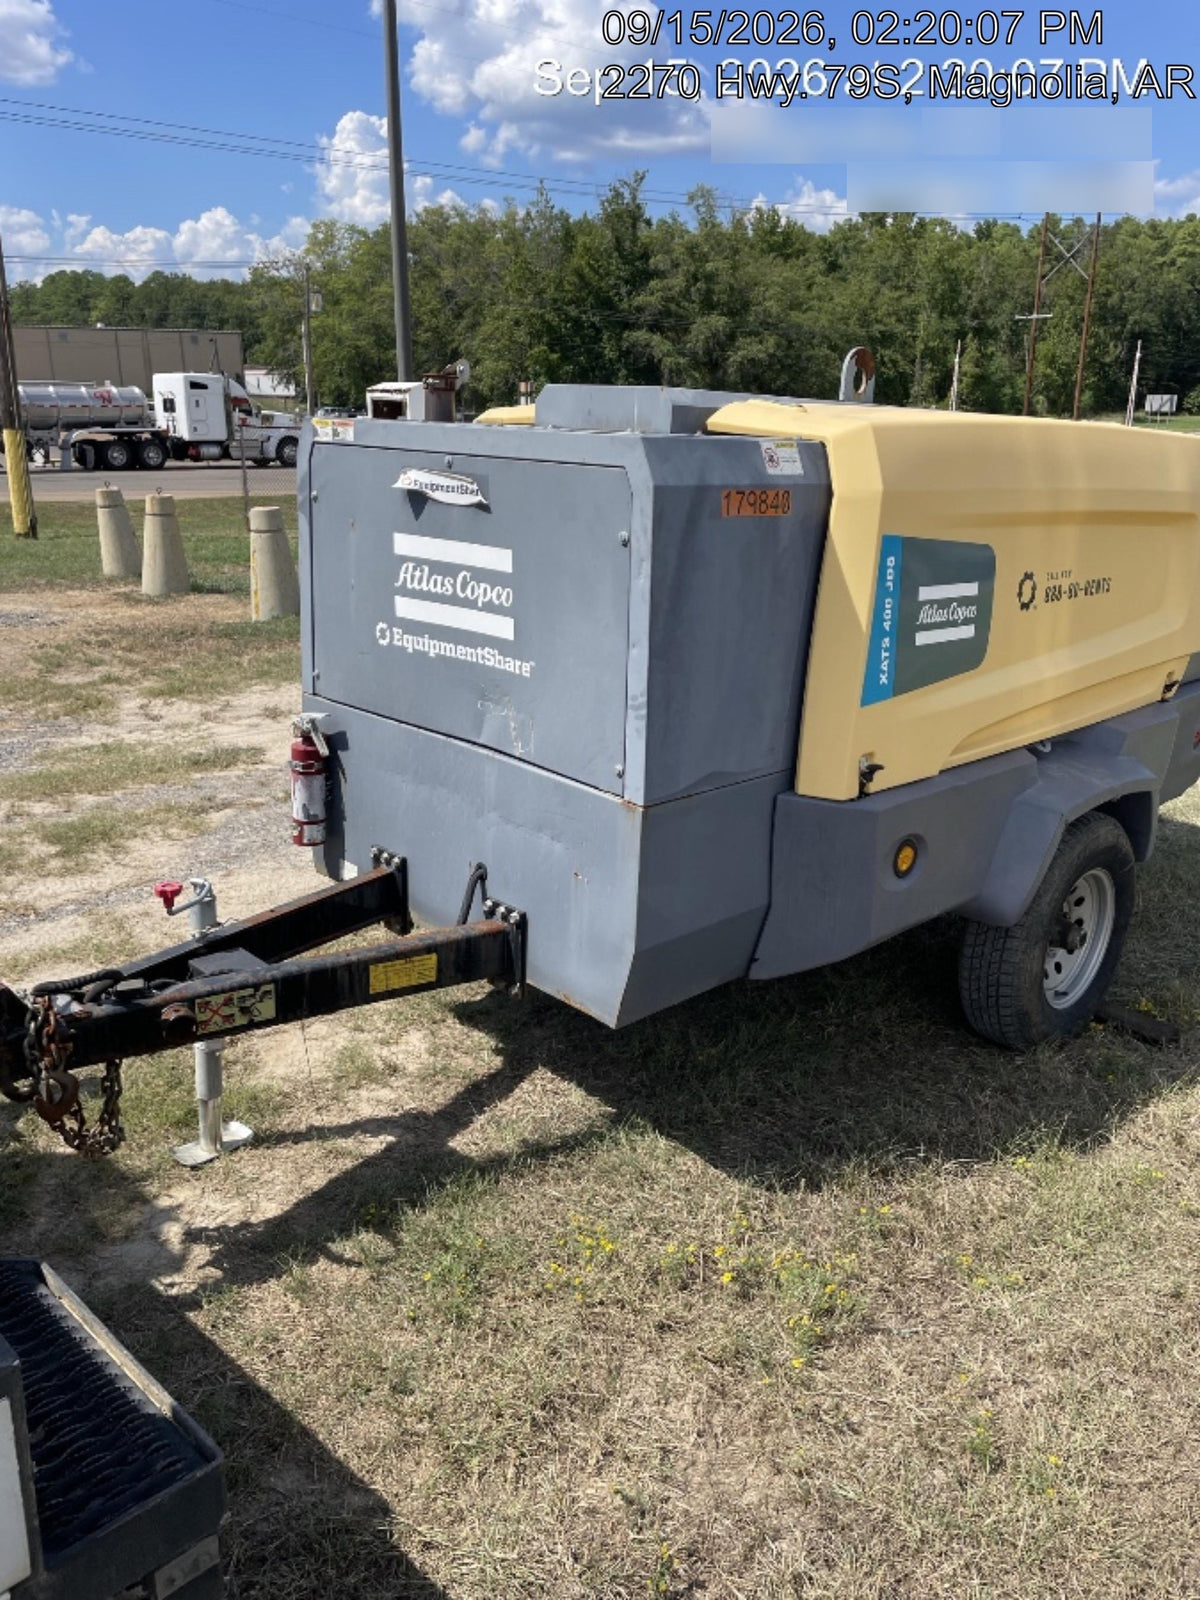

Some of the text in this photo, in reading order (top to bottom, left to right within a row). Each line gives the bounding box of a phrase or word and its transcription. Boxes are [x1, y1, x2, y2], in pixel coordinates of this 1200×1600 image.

[394, 561, 513, 608] Atlas Copco
[883, 598, 893, 633] 400
[916, 602, 977, 625] Atlas Copco
[879, 636, 891, 685] XATS
